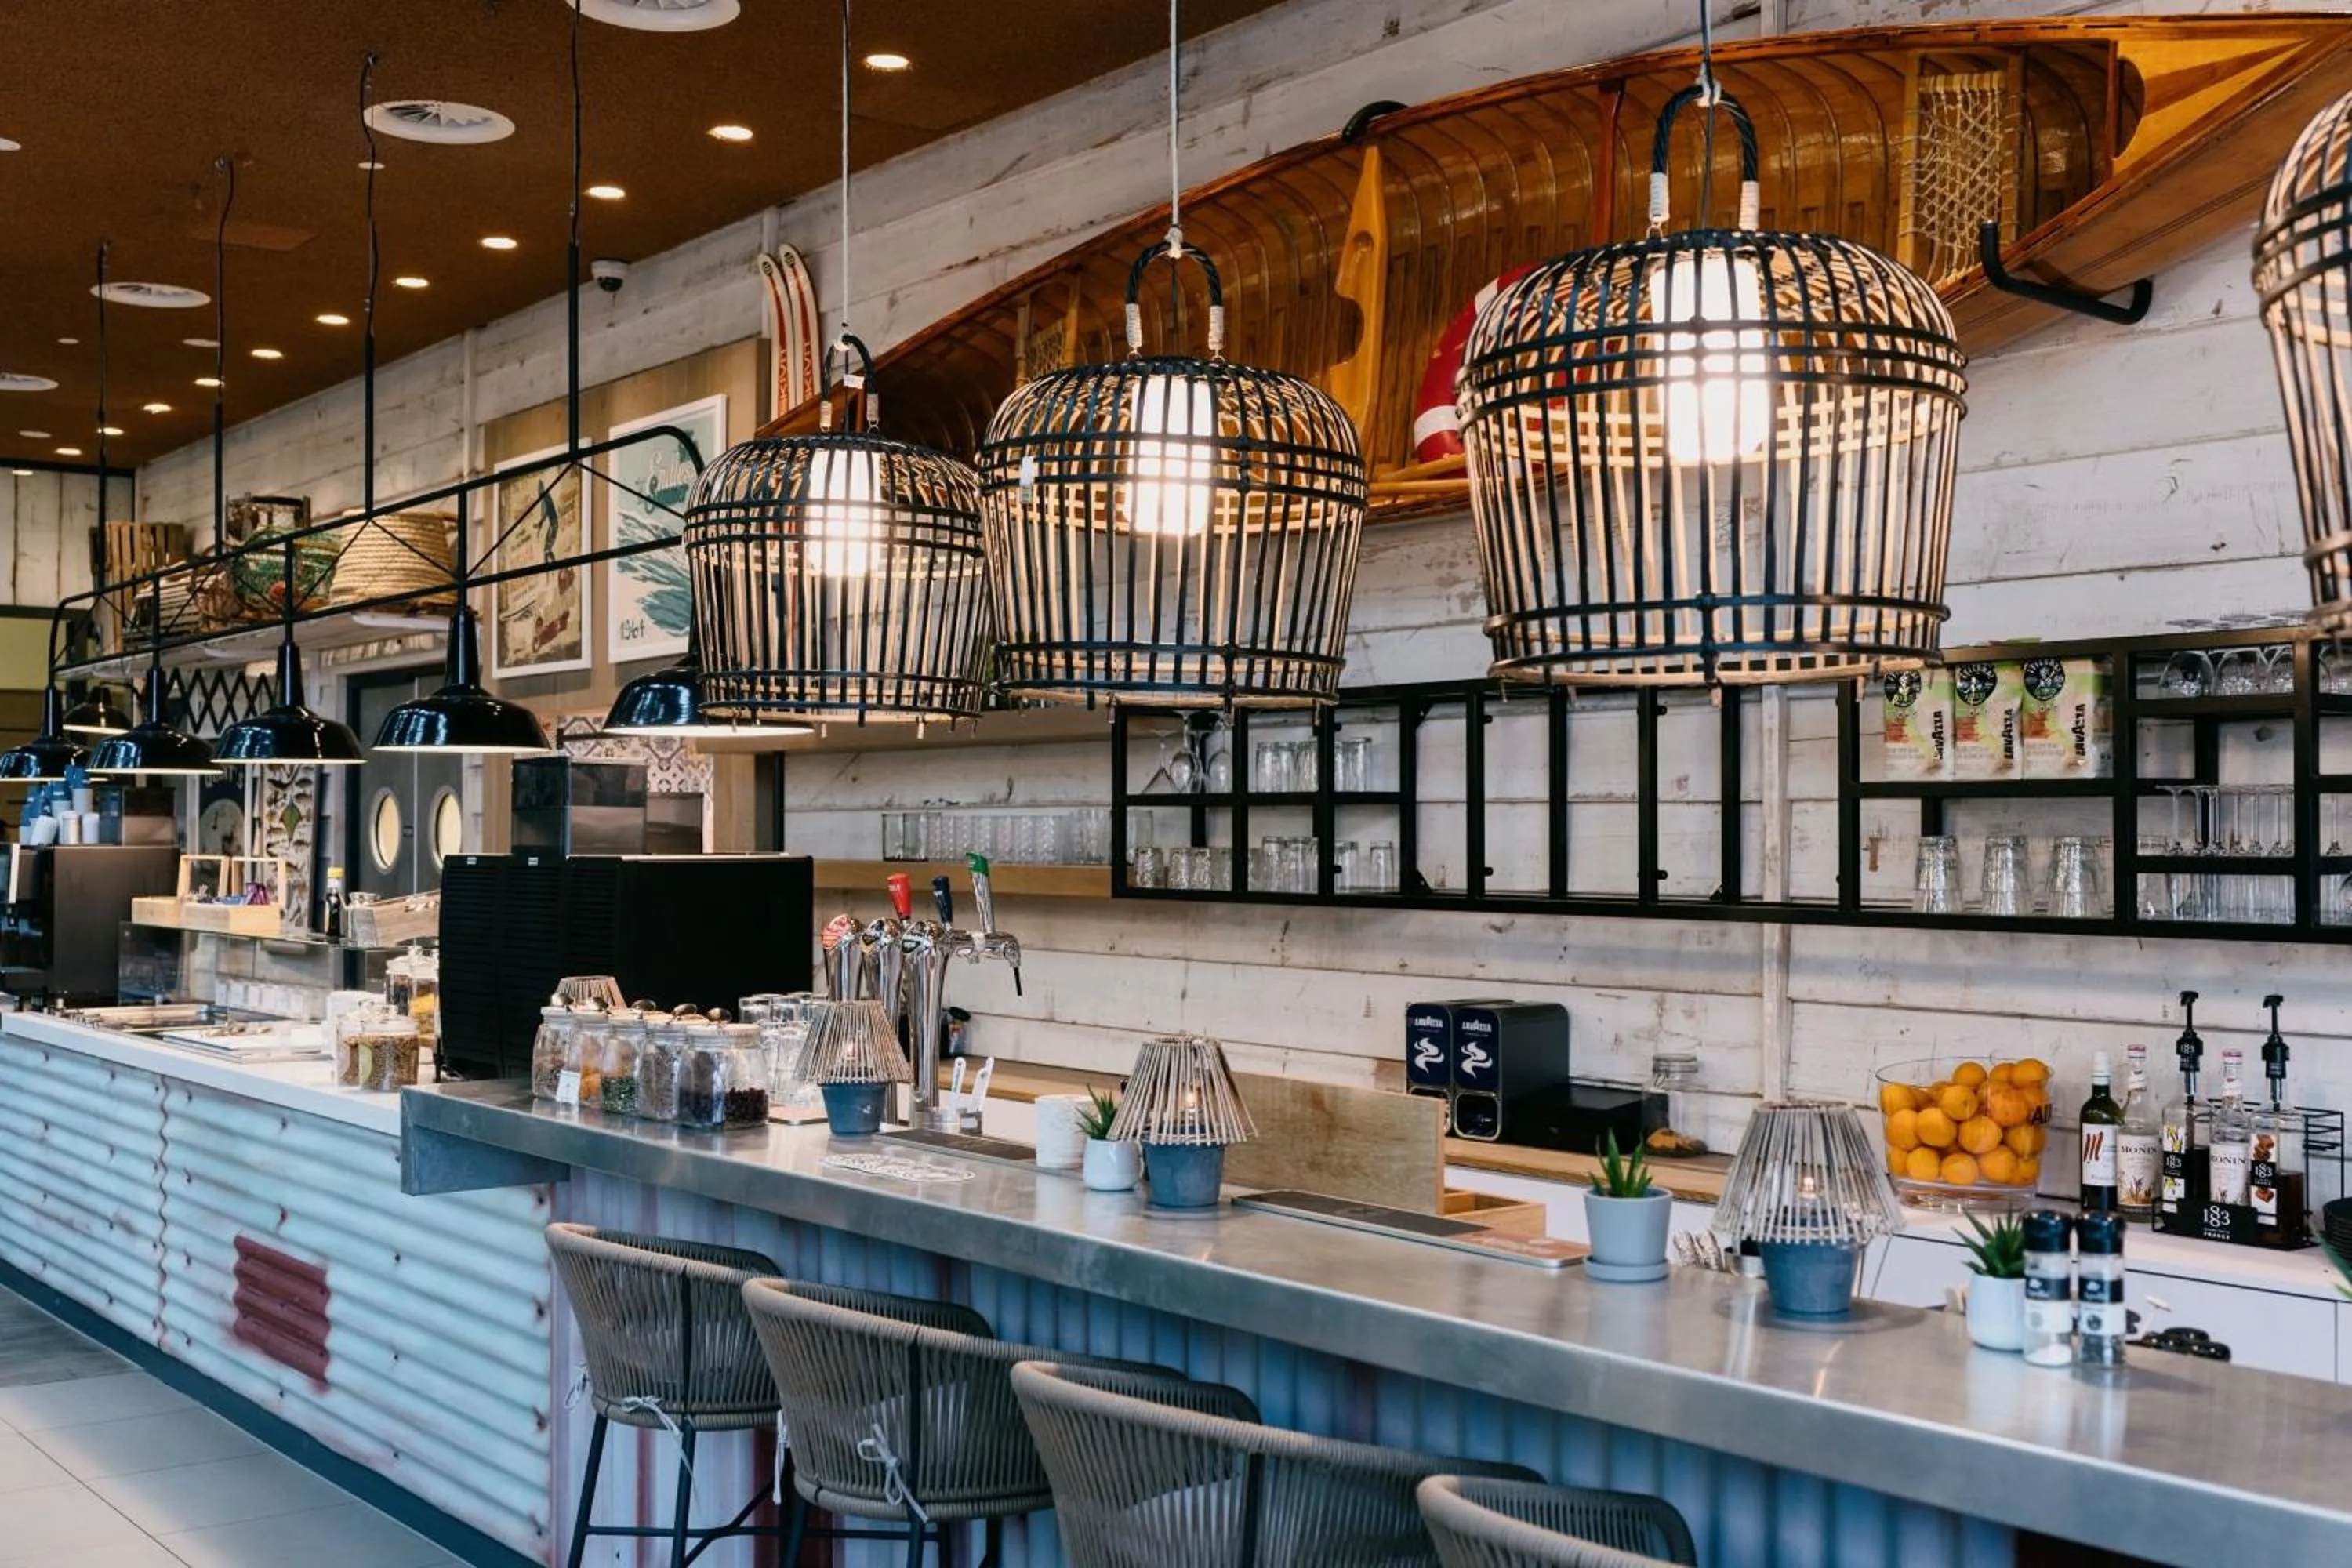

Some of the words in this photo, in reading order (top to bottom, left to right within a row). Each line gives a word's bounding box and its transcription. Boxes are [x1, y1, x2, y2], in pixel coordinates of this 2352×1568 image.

[2001, 708, 2014, 759] LAVAZZA
[2071, 703, 2085, 757] LAVAZZA
[1414, 1016, 1443, 1028] LAVAZZA
[1461, 1019, 1491, 1032] LAVAZZA
